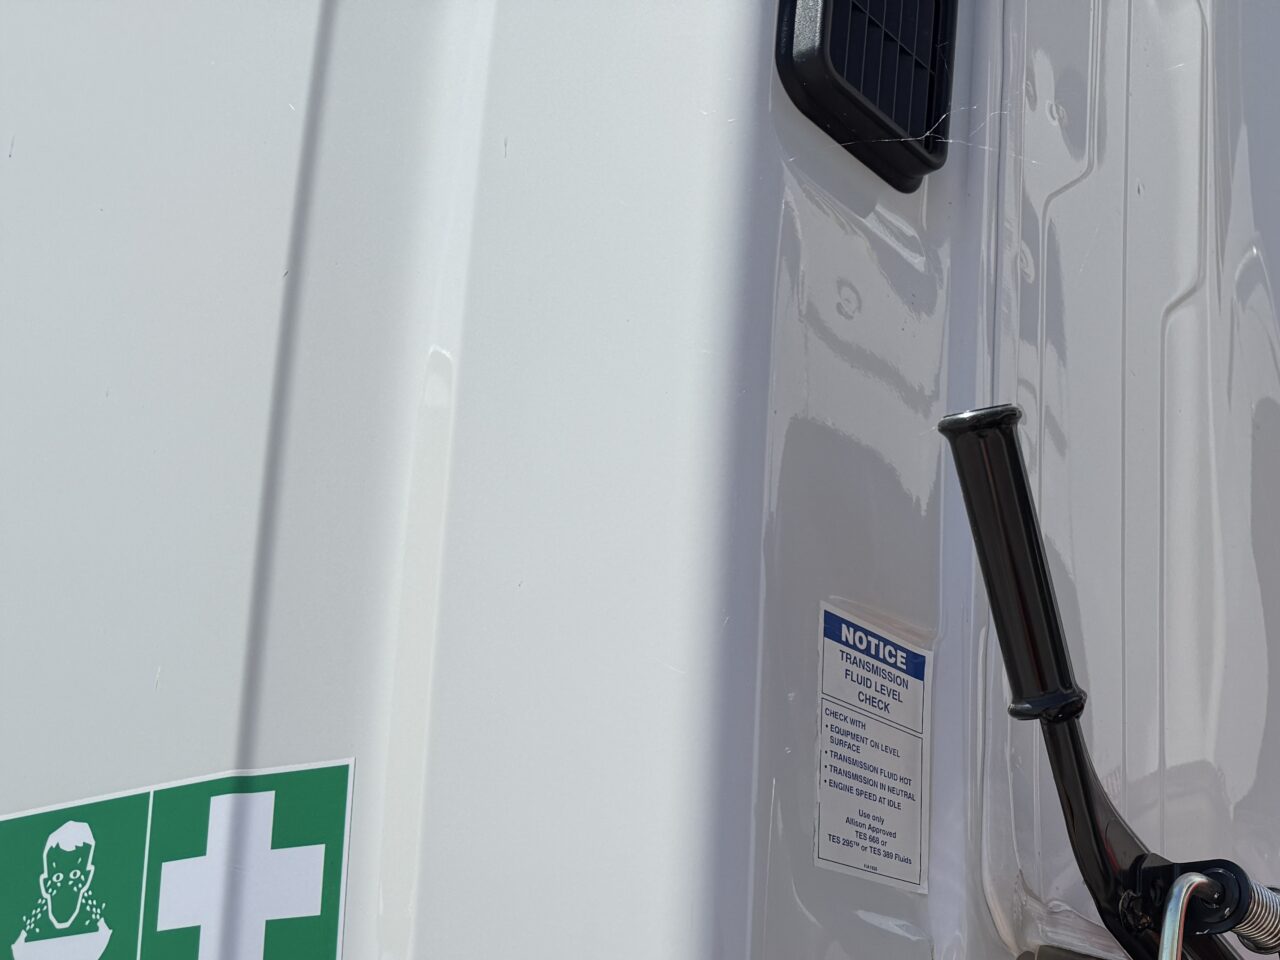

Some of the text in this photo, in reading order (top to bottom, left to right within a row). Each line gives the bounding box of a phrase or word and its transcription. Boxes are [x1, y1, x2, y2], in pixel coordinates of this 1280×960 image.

[841, 622, 906, 670] NOTICE
[839, 649, 908, 689] TRANSMISSION
[844, 668, 903, 703] FLUID LEVEL
[857, 689, 890, 713] CHECK
[824, 707, 865, 730] CHECK WITH
[829, 735, 860, 753] SURFACE
[830, 723, 900, 758] EQUIPMENT ON LEVEL
[829, 749, 912, 786] TRANSMISSION FLUID HOT
[829, 764, 916, 801] TRANSMISSION IN NEUTRAL
[828, 778, 901, 810] ENGINE SPEED AT IDLE
[845, 816, 896, 840] Allison Approved
[858, 808, 884, 825] Use only
[827, 833, 842, 845] TES
[860, 842, 867, 852] or
[868, 845, 881, 856] TES
[894, 852, 912, 865] Fluids
[855, 830, 887, 847] TES 668 or
